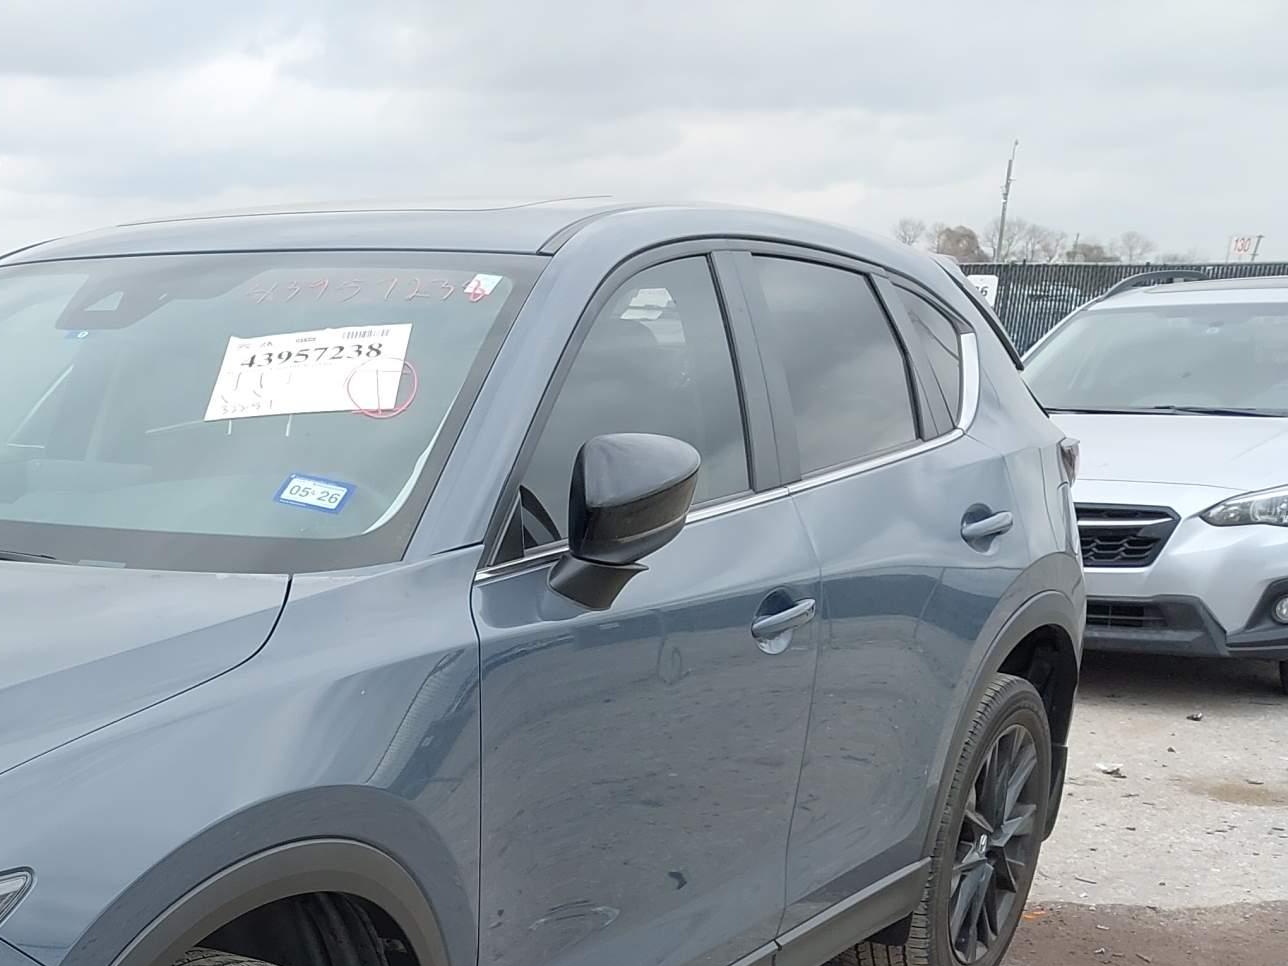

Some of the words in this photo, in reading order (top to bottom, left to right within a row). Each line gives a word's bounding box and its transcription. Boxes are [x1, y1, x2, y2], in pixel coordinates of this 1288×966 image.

[240, 342, 384, 369] 43957238
[289, 484, 312, 498] 05
[317, 490, 341, 504] 26
